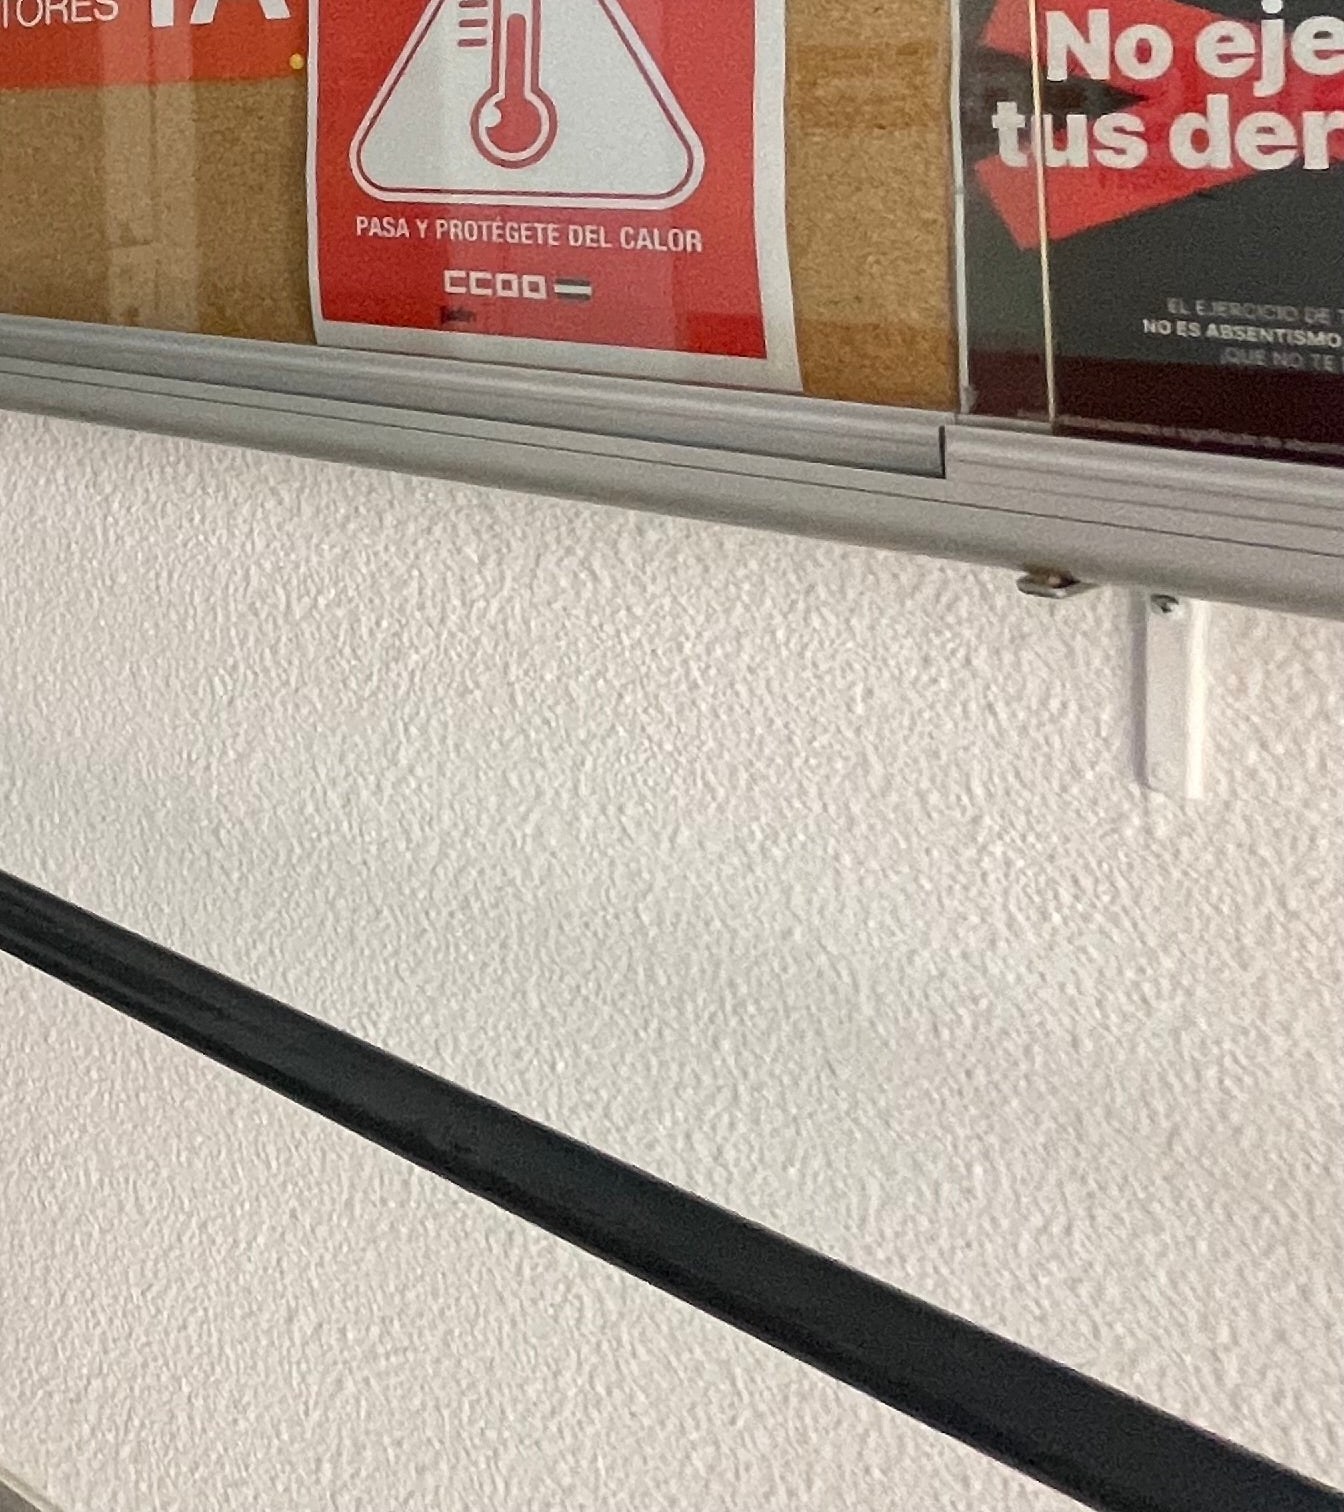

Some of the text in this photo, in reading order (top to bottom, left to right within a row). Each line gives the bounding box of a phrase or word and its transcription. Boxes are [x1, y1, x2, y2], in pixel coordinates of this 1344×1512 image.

[1045, 8, 1174, 81] No
[992, 101, 1149, 169] tus
[356, 216, 703, 253] PASA Y PROTÉGETE DEL CALOR
[443, 270, 547, 300] CCOO
[1167, 297, 1190, 315] EL
[1195, 299, 1299, 322] EJERCICIO
[1142, 318, 1343, 349] NO ES ABSENTISMO
[1272, 350, 1304, 369] NO
